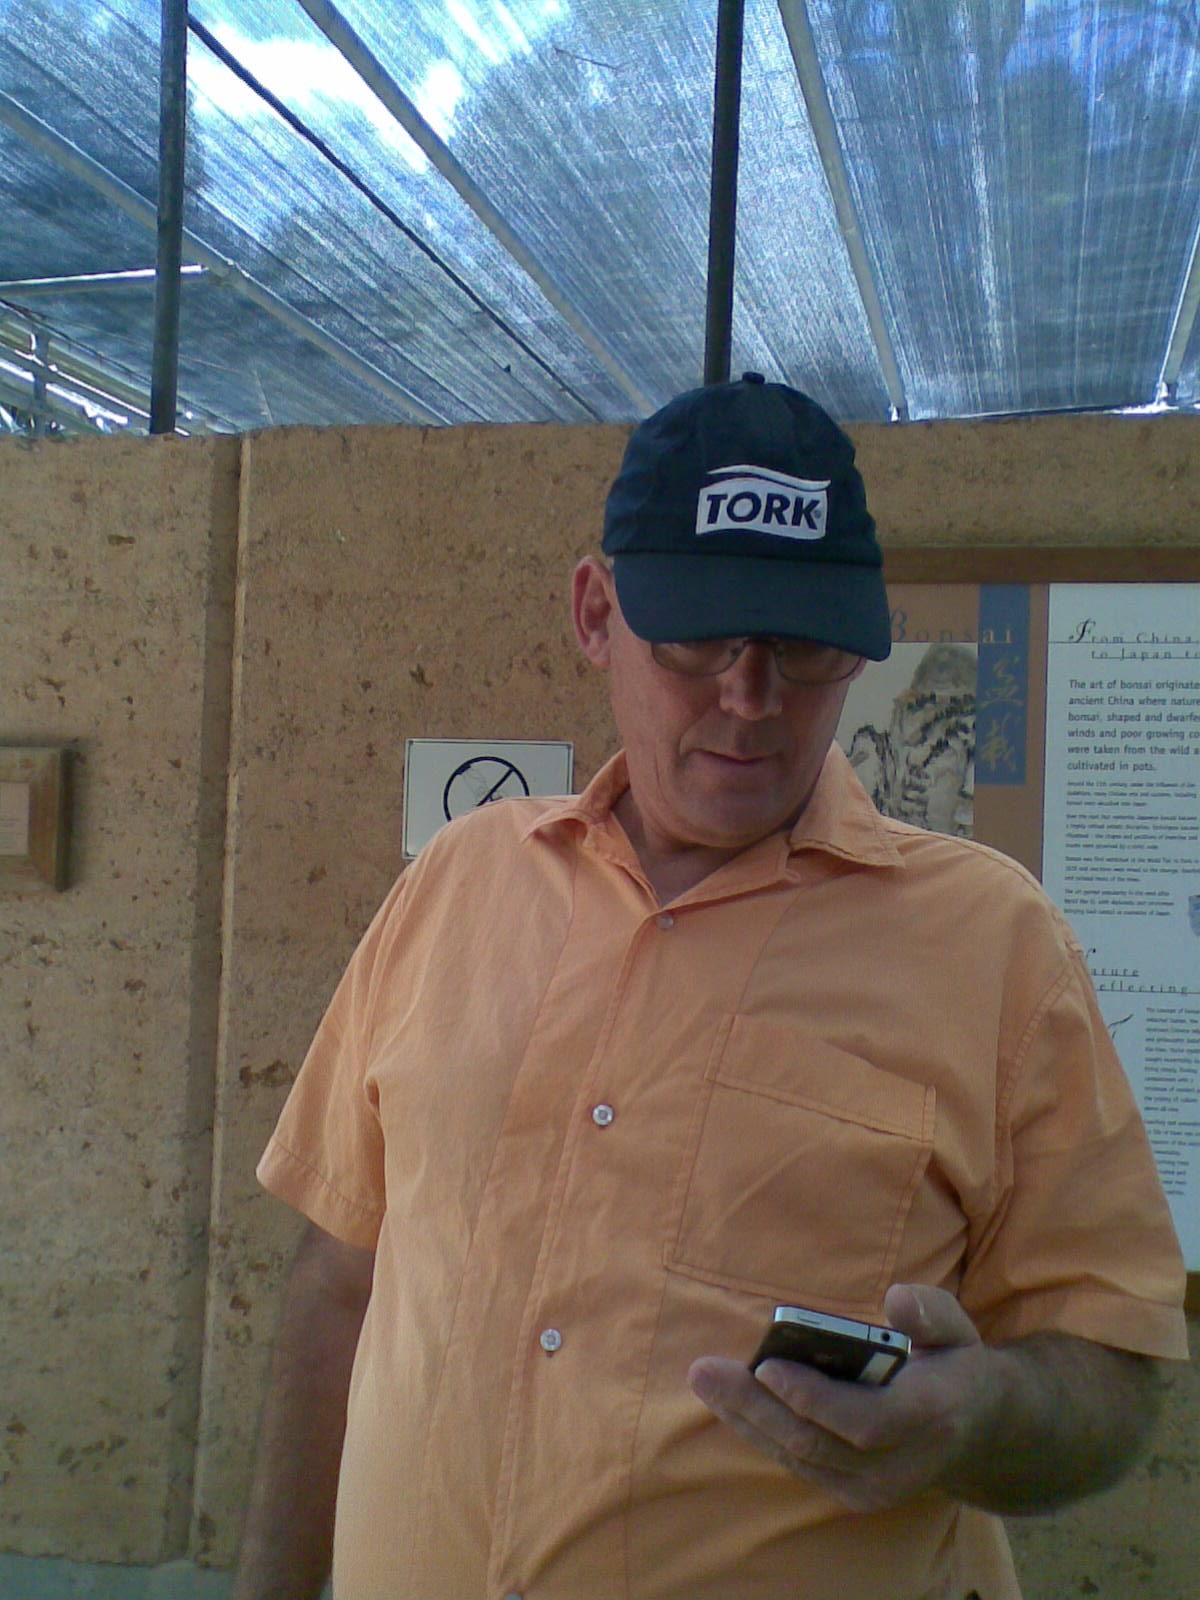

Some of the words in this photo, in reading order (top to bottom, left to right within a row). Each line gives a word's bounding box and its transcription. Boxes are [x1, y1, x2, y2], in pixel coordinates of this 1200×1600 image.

[706, 490, 821, 530] TORK
[1068, 617, 1124, 643] From
[1091, 650, 1108, 660] to
[1120, 648, 1172, 661] Japan
[1069, 680, 1087, 689] The
[1090, 680, 1103, 689] art
[1107, 680, 1117, 689] of
[1120, 680, 1152, 689] bonsai
[1068, 696, 1104, 705] ancient
[1108, 696, 1135, 705] China
[1138, 696, 1167, 705] where
[1106, 712, 1141, 723] shaped
[1145, 713, 1163, 722] and
[1067, 728, 1096, 738] winds
[1099, 728, 1117, 738] and
[1120, 730, 1142, 740] poor
[1146, 729, 1185, 741] growing
[1067, 746, 1090, 754] were
[1094, 744, 1120, 754] taken
[1124, 744, 1146, 754] from
[1150, 745, 1166, 755] the
[1169, 745, 1190, 755] wild
[1067, 760, 1115, 770] cultivated
[1119, 761, 1129, 770] in
[1099, 980, 1188, 996] eflecting
